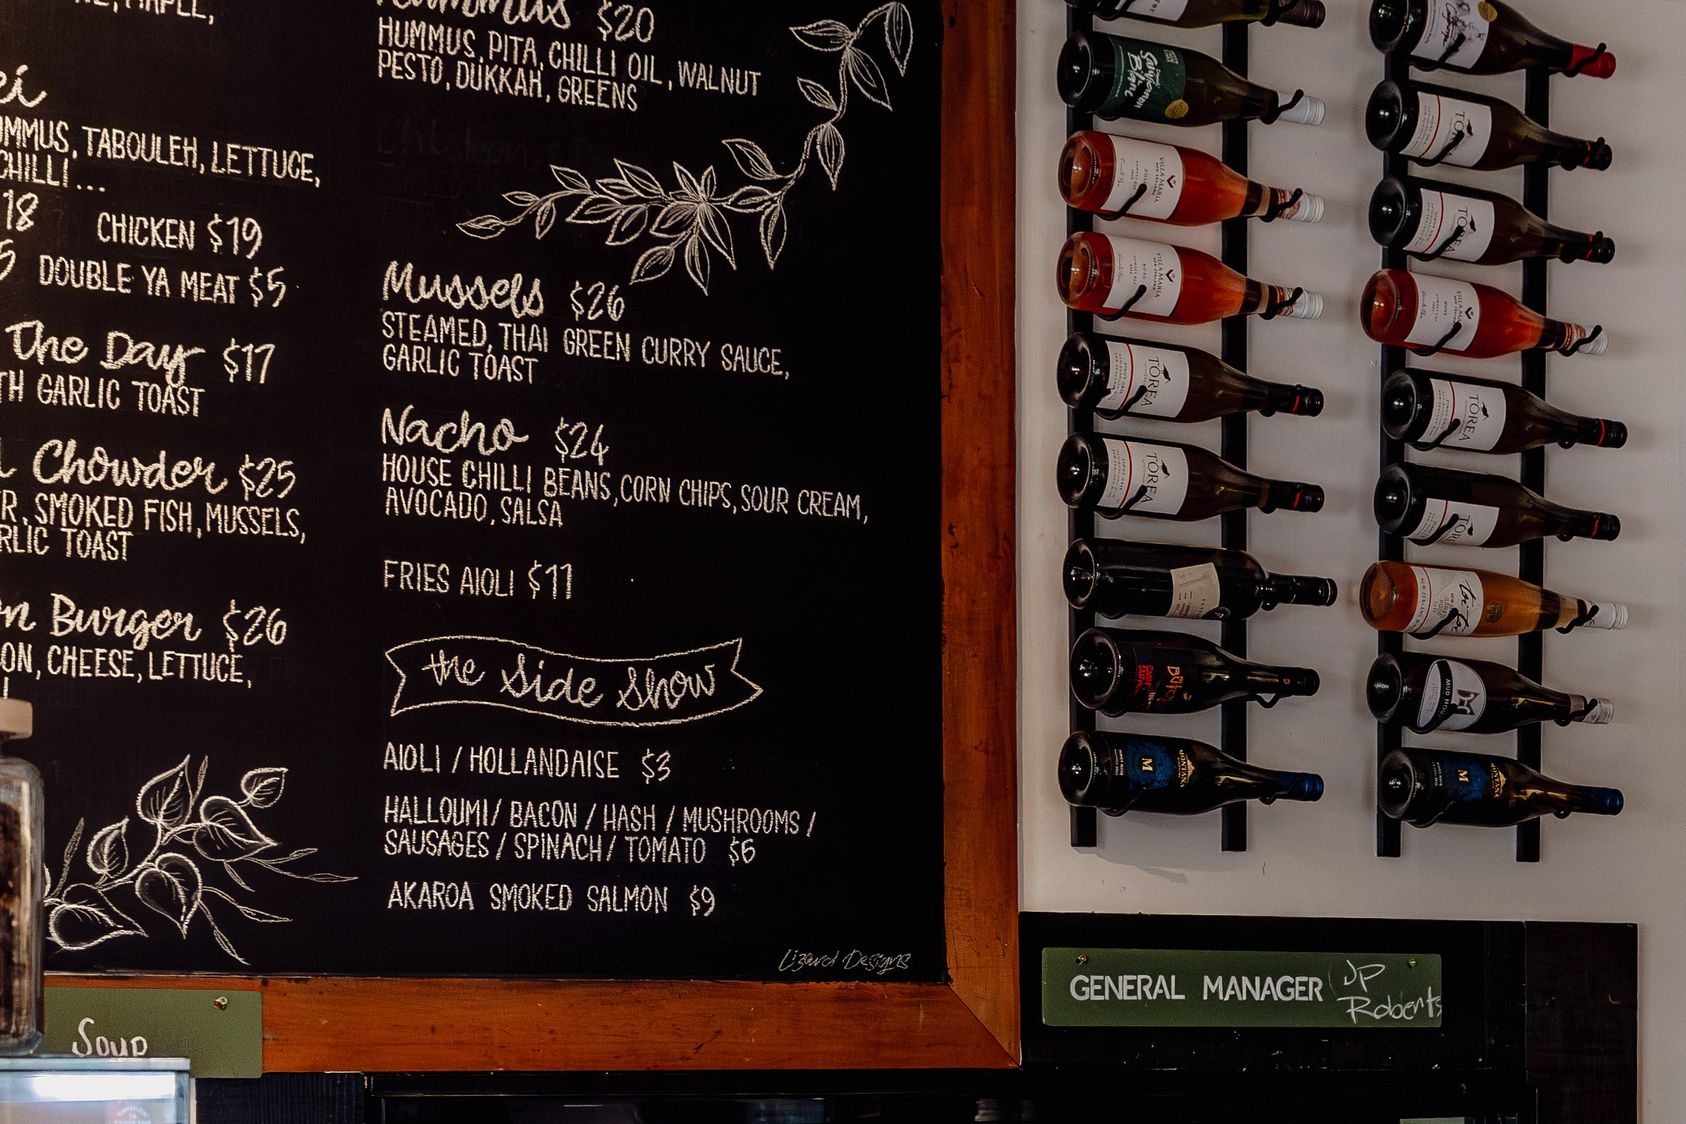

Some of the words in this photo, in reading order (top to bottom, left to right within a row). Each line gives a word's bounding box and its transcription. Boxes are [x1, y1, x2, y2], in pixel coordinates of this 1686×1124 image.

[597, 5, 655, 43] $20
[549, 41, 616, 78] CHILLI
[678, 61, 761, 97] WALNUT
[557, 75, 638, 112] GREENS
[82, 126, 204, 174] TABOULEH,
[212, 141, 320, 188] LETTUCE,
[97, 212, 195, 250] CHICKEN
[207, 213, 262, 259] $19
[39, 254, 133, 294] DOUBLE
[141, 265, 171, 298] YA
[180, 271, 240, 304] MEAT
[250, 266, 287, 308] $5
[382, 260, 545, 318] Mussels
[570, 280, 624, 321] $26
[5, 319, 89, 365] The
[100, 331, 206, 388] Day
[222, 338, 276, 383] $17
[382, 312, 491, 354] STEAMED,
[499, 322, 548, 354] THAI
[563, 328, 630, 363] GREEN
[641, 337, 711, 369] CURRY
[721, 343, 790, 380] SAUCE,
[383, 349, 460, 376] GARLIC
[471, 356, 538, 384] TOAST
[37, 373, 120, 410] GARLIC
[131, 380, 206, 417] TOAST
[380, 404, 529, 456] Nacho
[554, 417, 609, 465] $24
[33, 438, 228, 494] Chowder
[238, 454, 296, 501] $25
[382, 454, 451, 487] HOUSE
[462, 458, 531, 492] CHILLI
[543, 466, 617, 506] BEANS,
[621, 474, 671, 503] CORN
[679, 480, 737, 514] CHIPS,
[741, 487, 790, 514] SOUR
[798, 490, 870, 526] CREAM,
[35, 493, 134, 529] SMOKED
[143, 500, 203, 539] FISH,
[206, 502, 306, 545] MUSSELS,
[385, 489, 496, 526] AVOCADO,
[501, 499, 563, 528] SALSA
[61, 528, 133, 562] TOAST
[384, 560, 450, 593] FRIES
[460, 567, 514, 596] AIOLI
[528, 561, 573, 600] $11
[50, 593, 202, 651] Burger
[222, 599, 287, 652] $26
[47, 645, 143, 684] CHEESE,
[149, 651, 252, 689] LETTUCE,
[616, 664, 716, 711] Show
[383, 742, 440, 774] AIOLI
[470, 746, 620, 779] HOLLANDAISE
[642, 749, 671, 784] $3
[1141, 757, 1153, 771] M
[1457, 769, 1469, 782] M
[510, 800, 577, 829] BACON
[603, 803, 656, 833] HASH
[683, 806, 799, 835] MUSHROOMS
[384, 831, 490, 858] SAUSAGES
[624, 836, 706, 863] TOMATO
[729, 839, 756, 866] $6
[387, 881, 474, 910] AKAROA
[490, 883, 572, 911] SMOKED
[587, 885, 669, 912] SALMON
[690, 887, 716, 916] $9
[1070, 974, 1185, 1001] GENERAL
[1203, 975, 1323, 1002] MANAGER
[1343, 959, 1386, 992] JP
